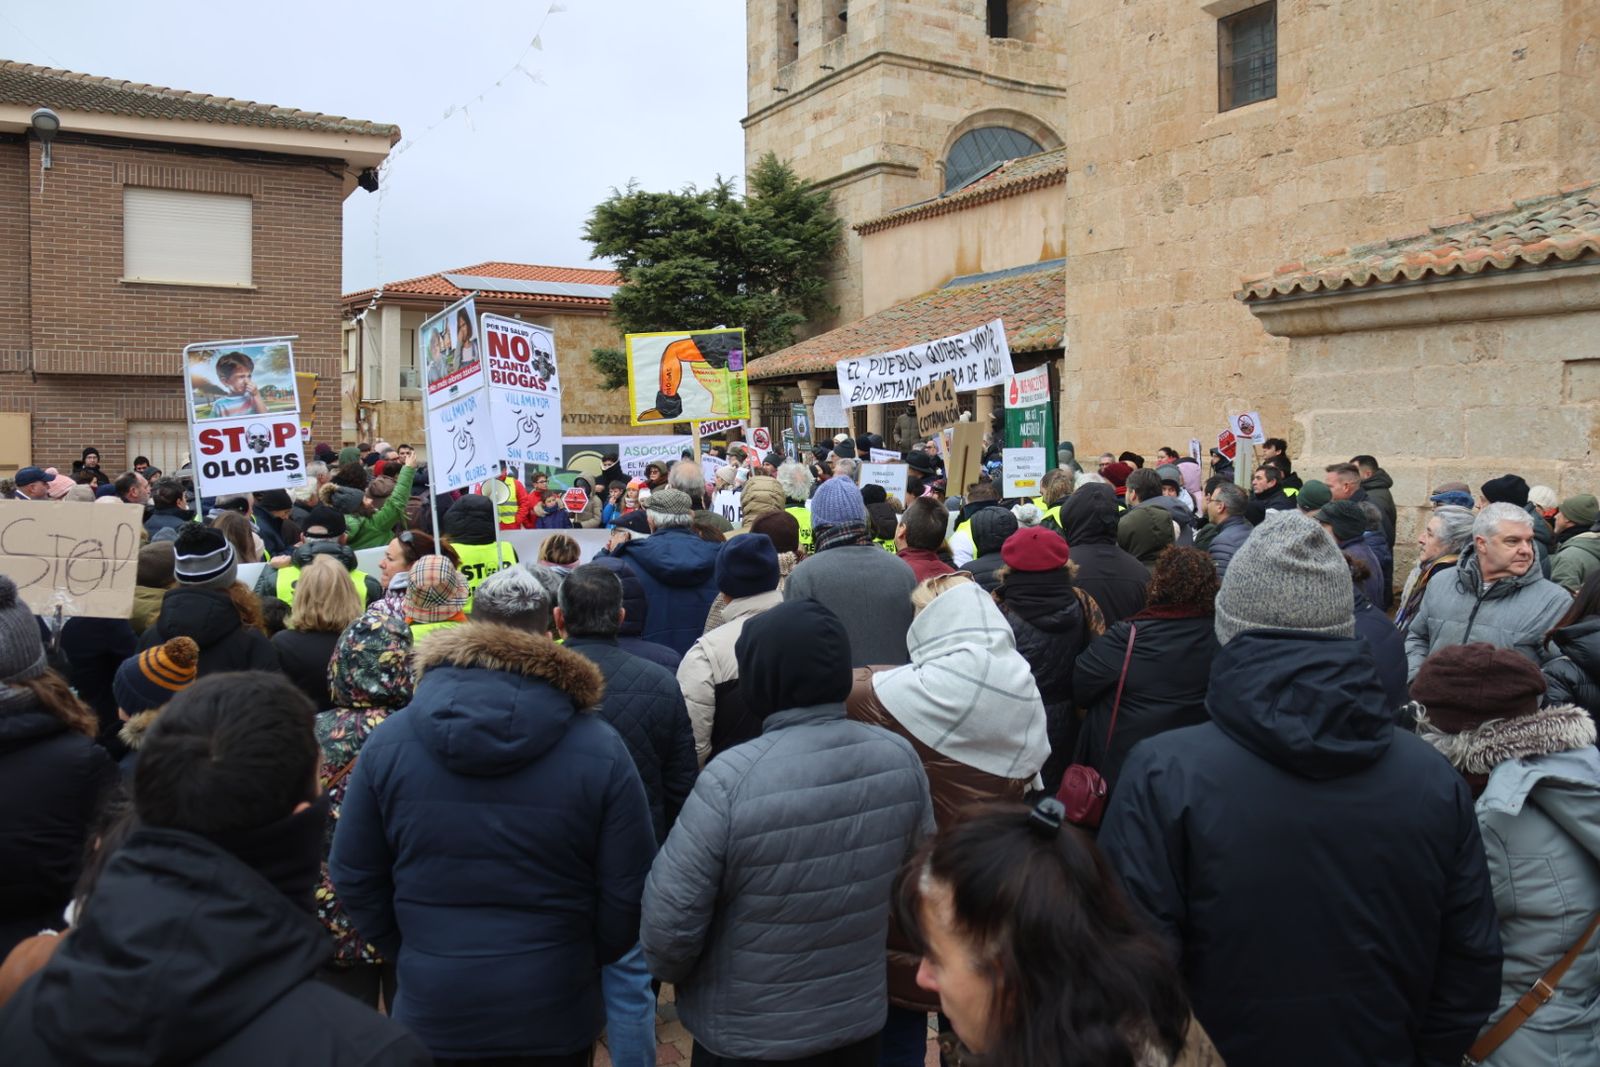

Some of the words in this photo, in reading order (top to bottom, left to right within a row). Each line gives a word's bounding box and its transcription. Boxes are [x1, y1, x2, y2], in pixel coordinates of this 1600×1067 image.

[510, 328, 529, 337] SALUD
[487, 331, 530, 362] NO
[489, 359, 531, 374] PLANTA
[848, 361, 860, 380] EL
[867, 351, 922, 378] PUEBLO
[926, 338, 967, 364] QUIERE
[491, 370, 547, 391] BIOGÁS
[967, 363, 978, 384] DE
[441, 396, 477, 422] VILLAMAYOR
[505, 391, 549, 409] VILLAMAYOR
[508, 447, 521, 459] SIN
[527, 450, 549, 462] OLORES
[203, 453, 299, 479] OLORES
[448, 473, 460, 486] SIN
[465, 464, 487, 481] OLORES
[1, 518, 134, 596] STOP
